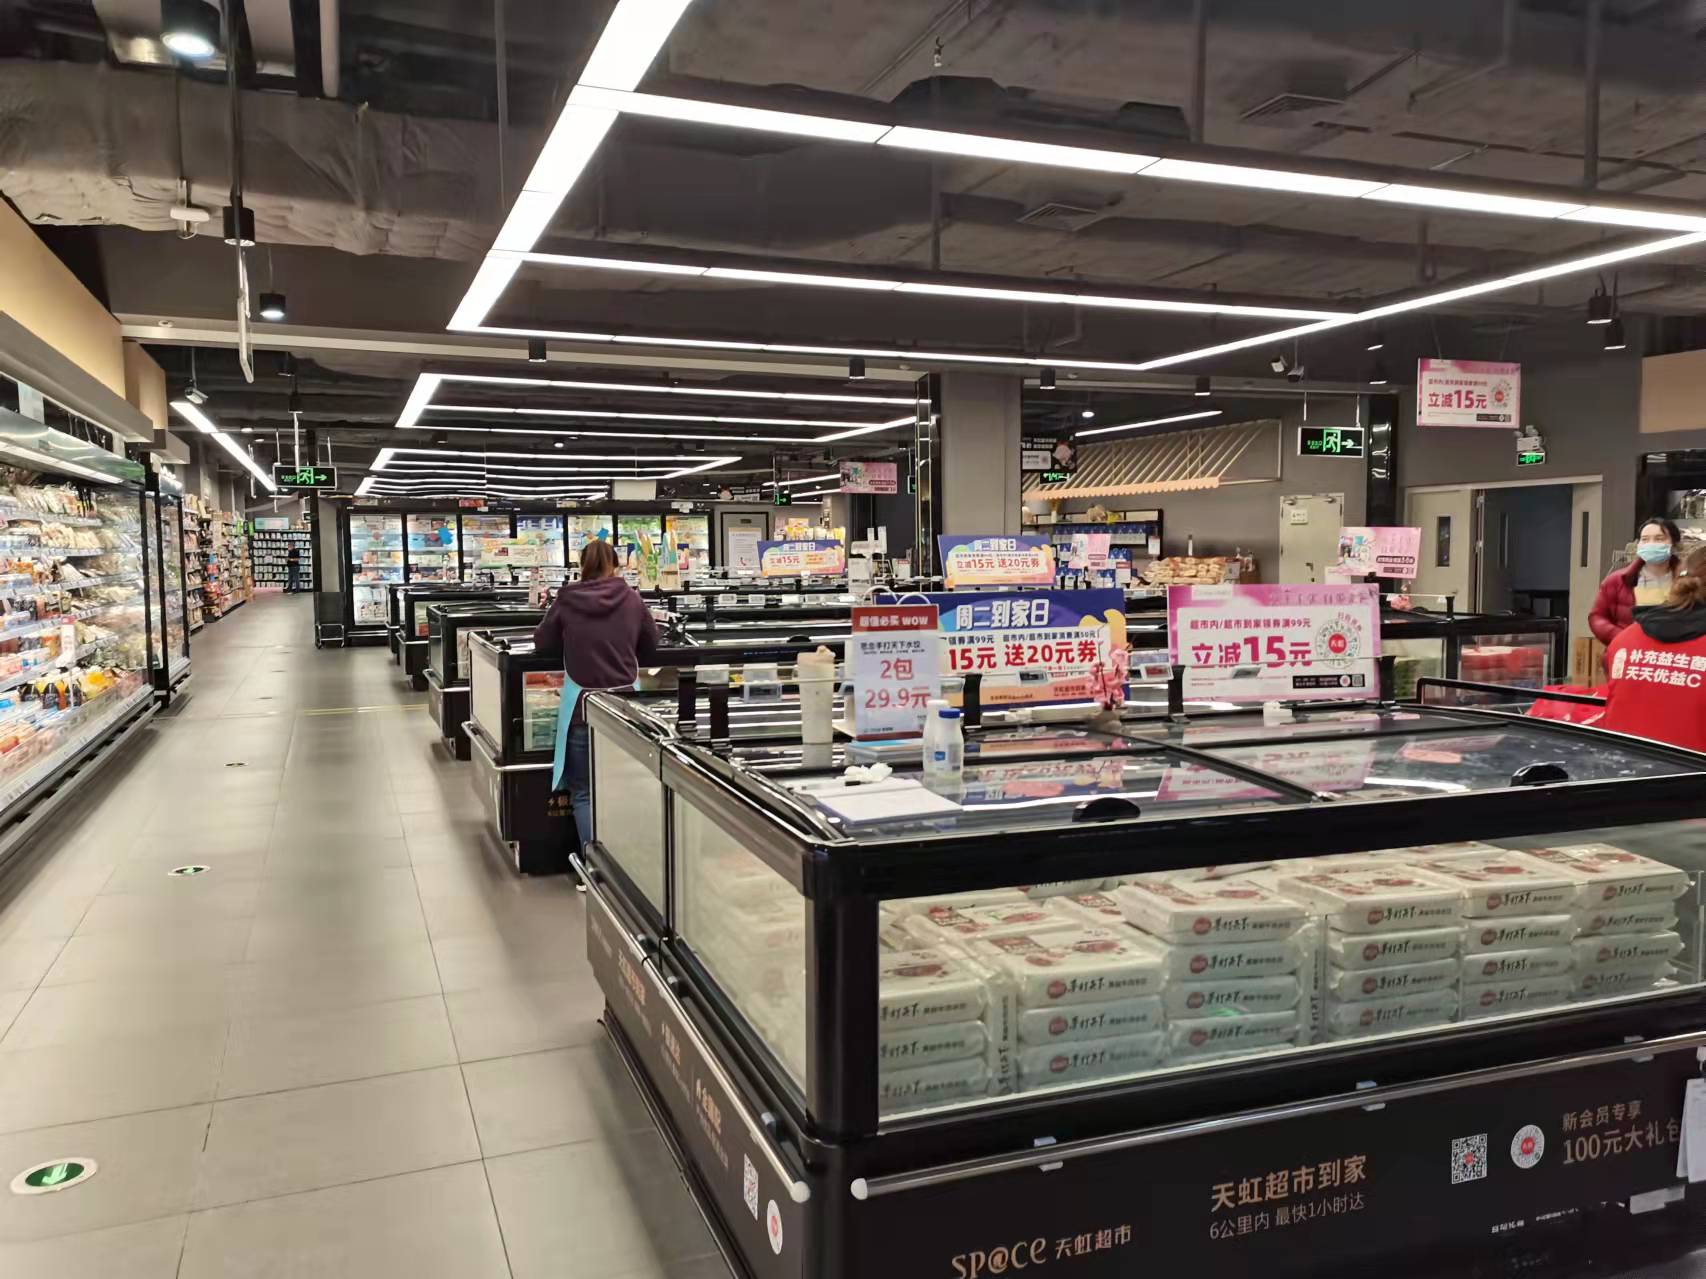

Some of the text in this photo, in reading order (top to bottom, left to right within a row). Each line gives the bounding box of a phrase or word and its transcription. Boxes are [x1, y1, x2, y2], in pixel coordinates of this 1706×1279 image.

[1428, 390, 1487, 408] 立减15元
[956, 599, 1049, 631] 周二到家日
[940, 634, 995, 646] 领券满99元
[1192, 635, 1313, 668] 立减15元
[880, 658, 914, 681] 2包
[949, 641, 1097, 670] 15元 送20元券
[1630, 649, 1706, 671] 补充益生菌
[1625, 666, 1702, 688] 天天优益C
[865, 686, 931, 709] 29.9元
[1562, 1100, 1642, 1131] 新会员专享
[1563, 1118, 1679, 1165] 100元大礼包
[1211, 1154, 1367, 1212] 天虹超市到家
[1209, 1192, 1365, 1240] 6公里内 最快1小时达
[1055, 1224, 1131, 1259] 天虹超市
